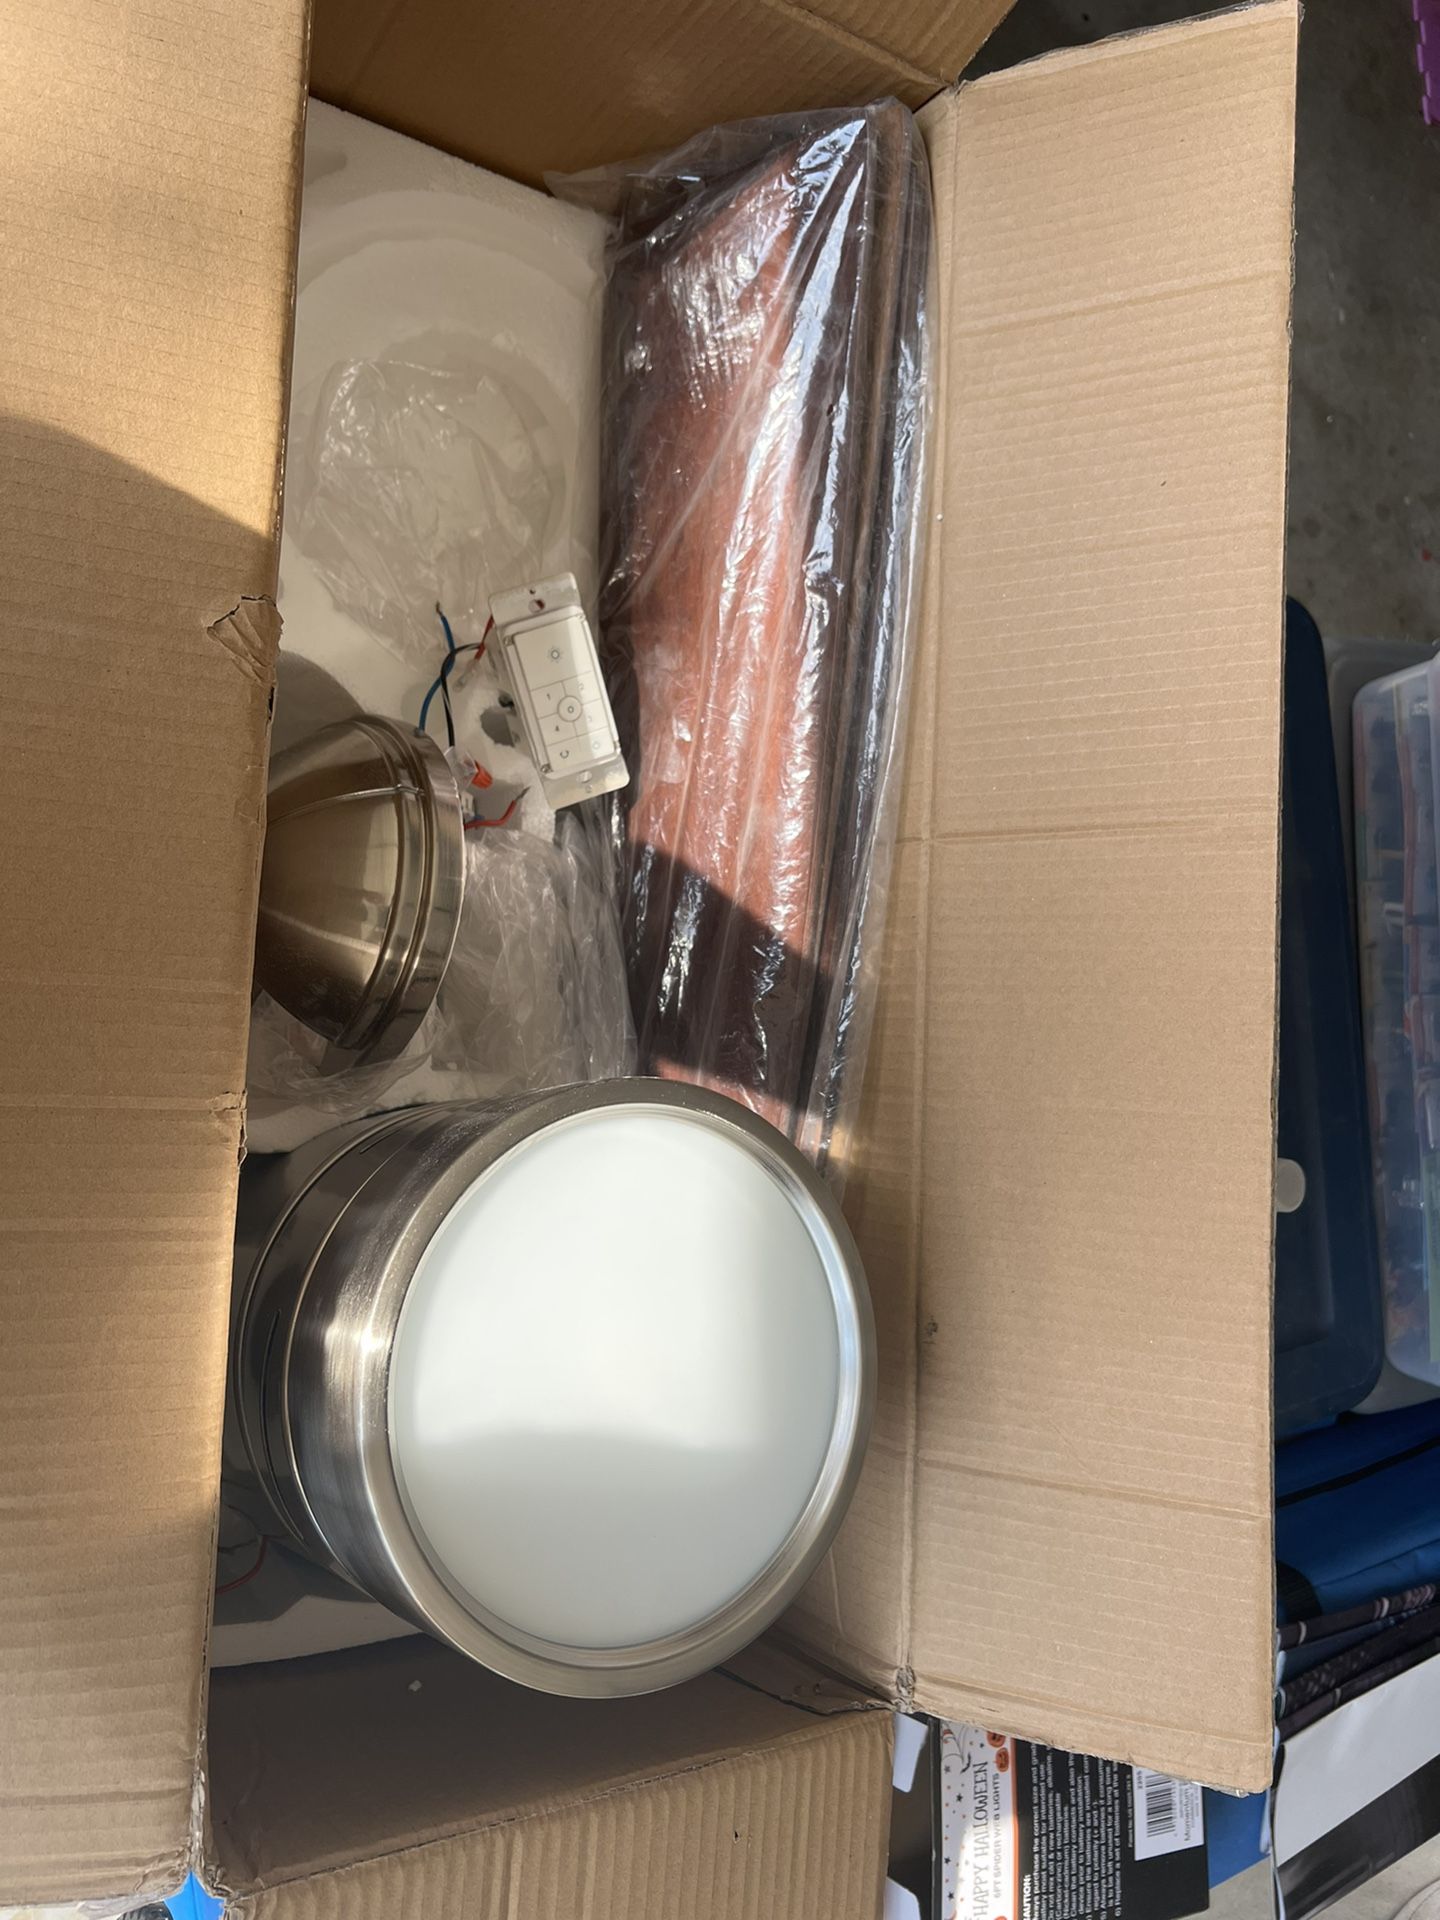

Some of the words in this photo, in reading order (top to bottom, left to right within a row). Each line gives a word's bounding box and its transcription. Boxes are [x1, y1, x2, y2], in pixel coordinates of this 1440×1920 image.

[992, 1773, 1000, 1811] LIGHTS
[972, 1762, 989, 1857] HALLOWEEN
[1078, 1824, 1086, 1853] battery
[1114, 1838, 1120, 1846] of
[993, 1840, 1002, 1878] SPIDER
[1056, 1852, 1062, 1860] or
[1078, 1854, 1084, 1864] to
[1093, 1872, 1098, 1881] to
[1108, 1876, 1113, 1887] be
[972, 1864, 989, 1916] HAPPY
[1100, 1879, 1108, 1909] Always
[1108, 1888, 1113, 1898] to
[1114, 1907, 1121, 1916] 6)
